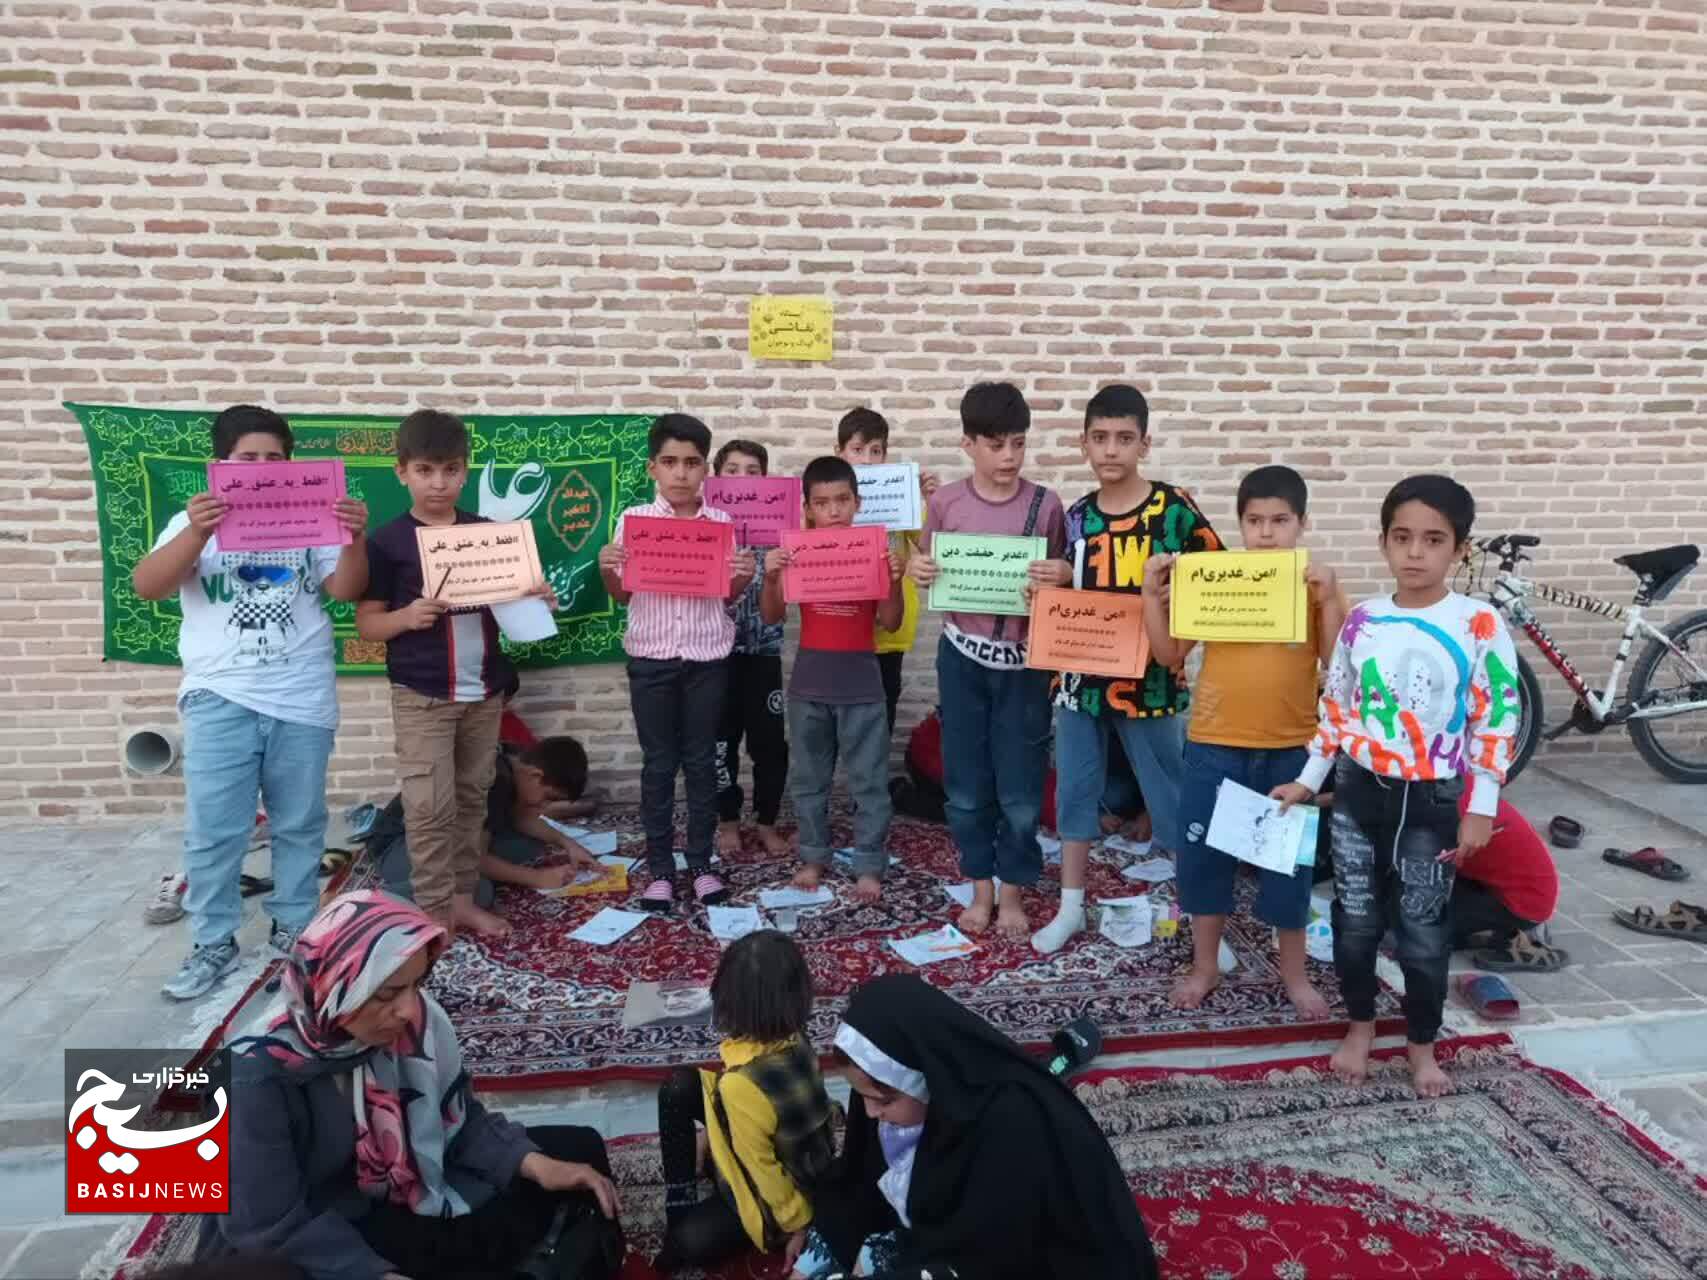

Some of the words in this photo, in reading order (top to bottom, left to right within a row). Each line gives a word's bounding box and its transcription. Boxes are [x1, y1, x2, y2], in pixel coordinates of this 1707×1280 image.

[221, 475, 329, 493] #فقط_به_عشق_علی
[428, 535, 520, 553] #فقط_به_عشق_علی
[941, 547, 1029, 562] #غدیر_حقیقت_دین
